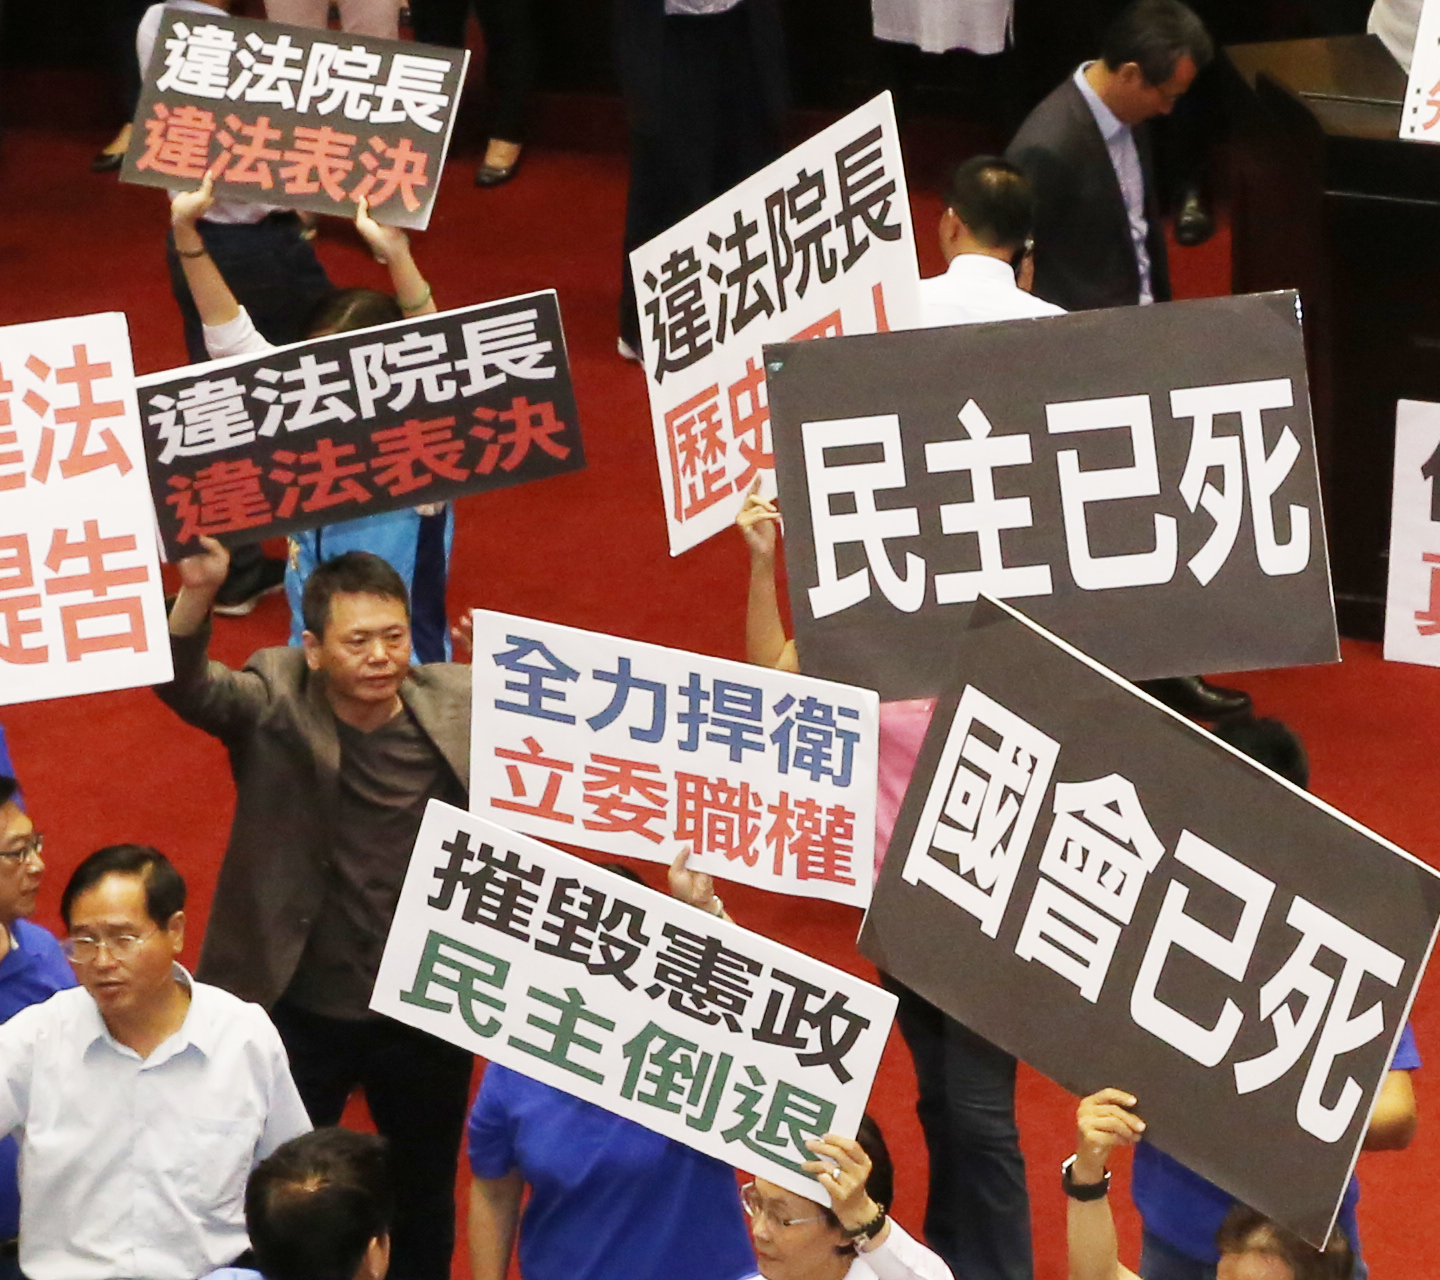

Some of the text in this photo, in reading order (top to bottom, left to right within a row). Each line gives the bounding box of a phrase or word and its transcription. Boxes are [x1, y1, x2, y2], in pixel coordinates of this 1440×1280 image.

[156, 21, 451, 132] 違法院長
[137, 103, 428, 214] 違法表決
[644, 125, 902, 386] 違法院長
[147, 308, 556, 464] 違法院長
[166, 396, 571, 545] 違法表決
[800, 378, 1311, 620] 民主已死
[492, 632, 861, 789] 全力捍衛
[489, 736, 858, 889] 立委職權
[424, 829, 872, 1085] 摧毀憲政
[900, 684, 1406, 1144] 國會已死
[399, 928, 841, 1172] 民主倒退
